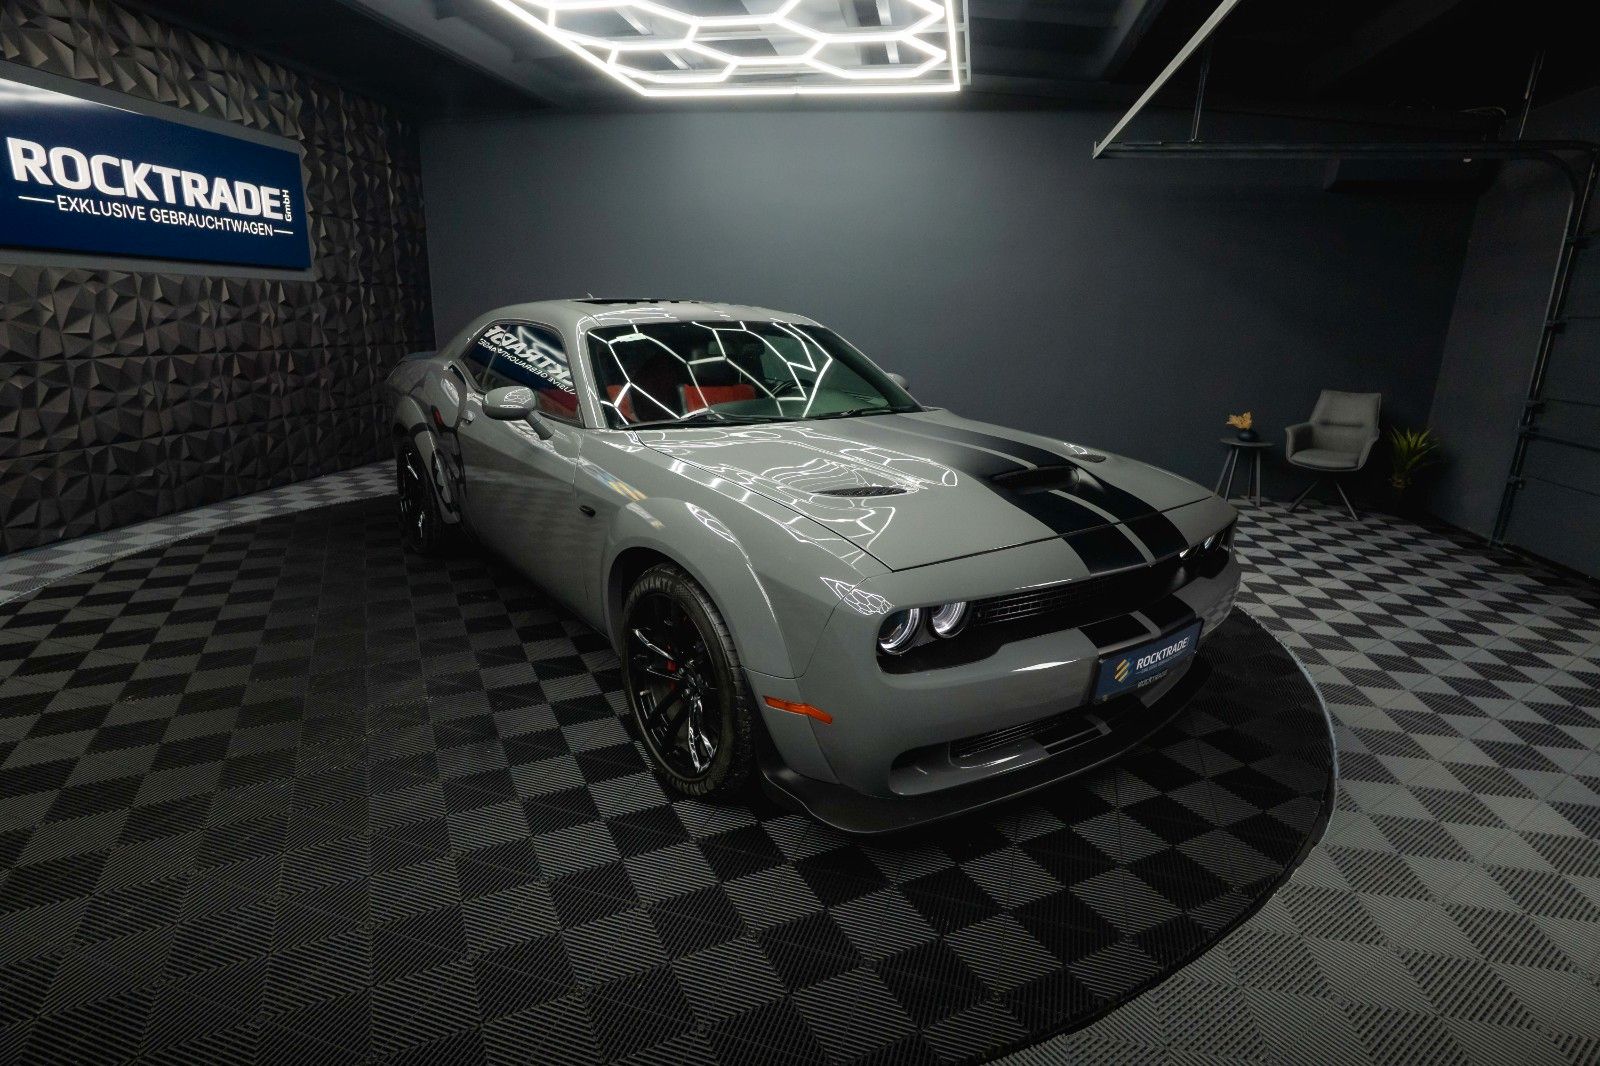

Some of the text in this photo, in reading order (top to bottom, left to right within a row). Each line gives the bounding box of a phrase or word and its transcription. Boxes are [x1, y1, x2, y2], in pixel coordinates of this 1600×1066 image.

[6, 136, 284, 220] ROCKTRADE
[56, 194, 274, 237] EXKLUSIVE GEBRAUCHTWAGEN
[282, 189, 293, 222] GmbH
[1136, 637, 1188, 671] ROCKTRADE
